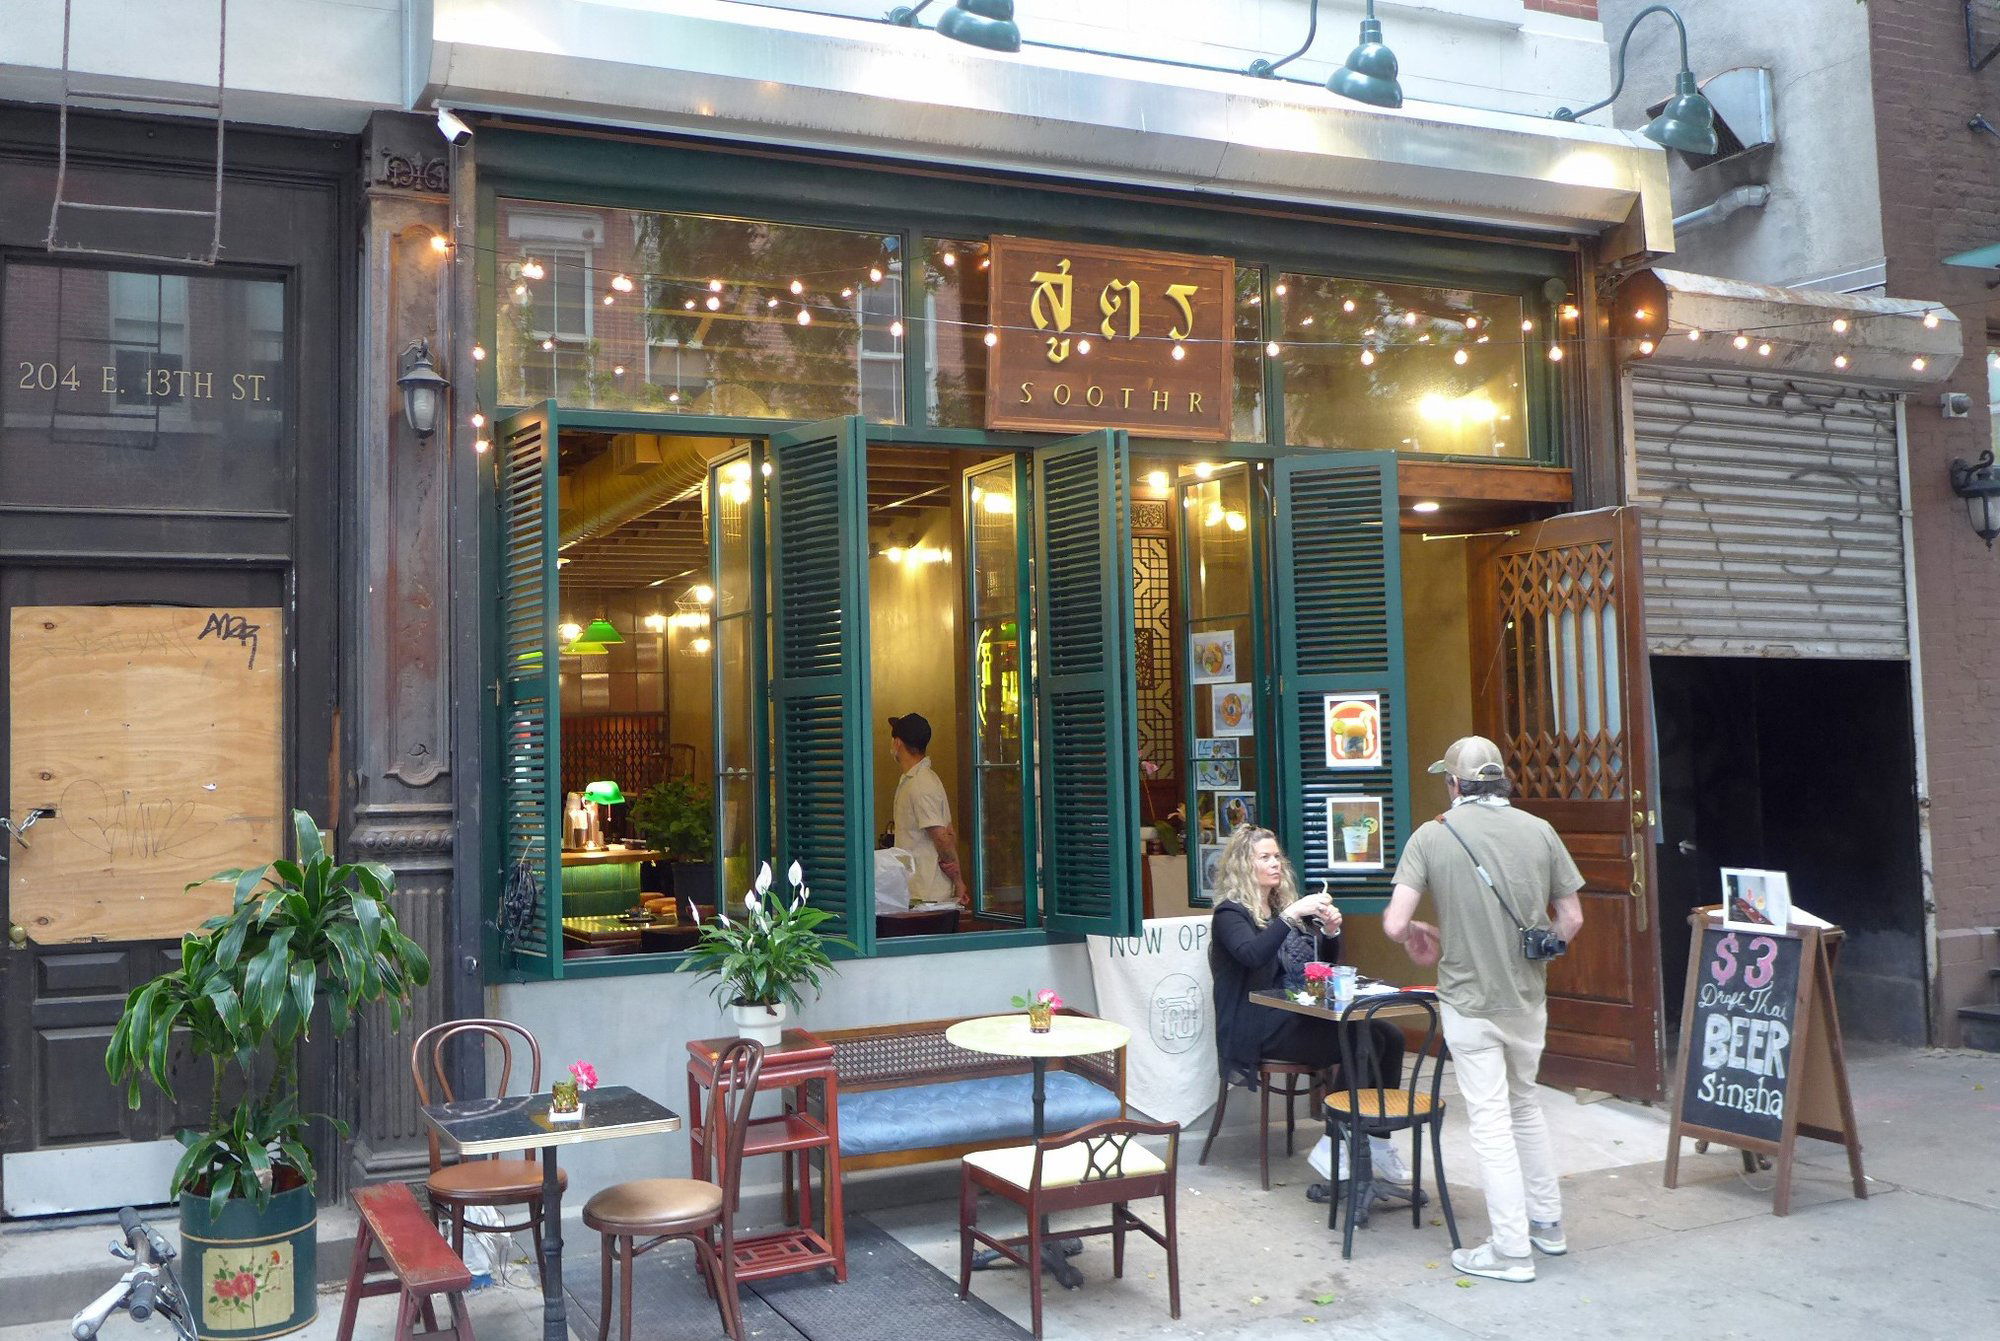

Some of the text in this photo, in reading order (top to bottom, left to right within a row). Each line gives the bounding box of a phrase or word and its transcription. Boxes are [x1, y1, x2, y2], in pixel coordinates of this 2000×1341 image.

[19, 362, 271, 402] 204 E. 13TH ST.
[1020, 382, 1203, 413] SOOTHR
[1110, 924, 1208, 957] NOW OP
[1698, 981, 1788, 1020] Draft Thai
[1702, 1013, 1790, 1079] BEER
[1697, 1072, 1784, 1120] Singha
